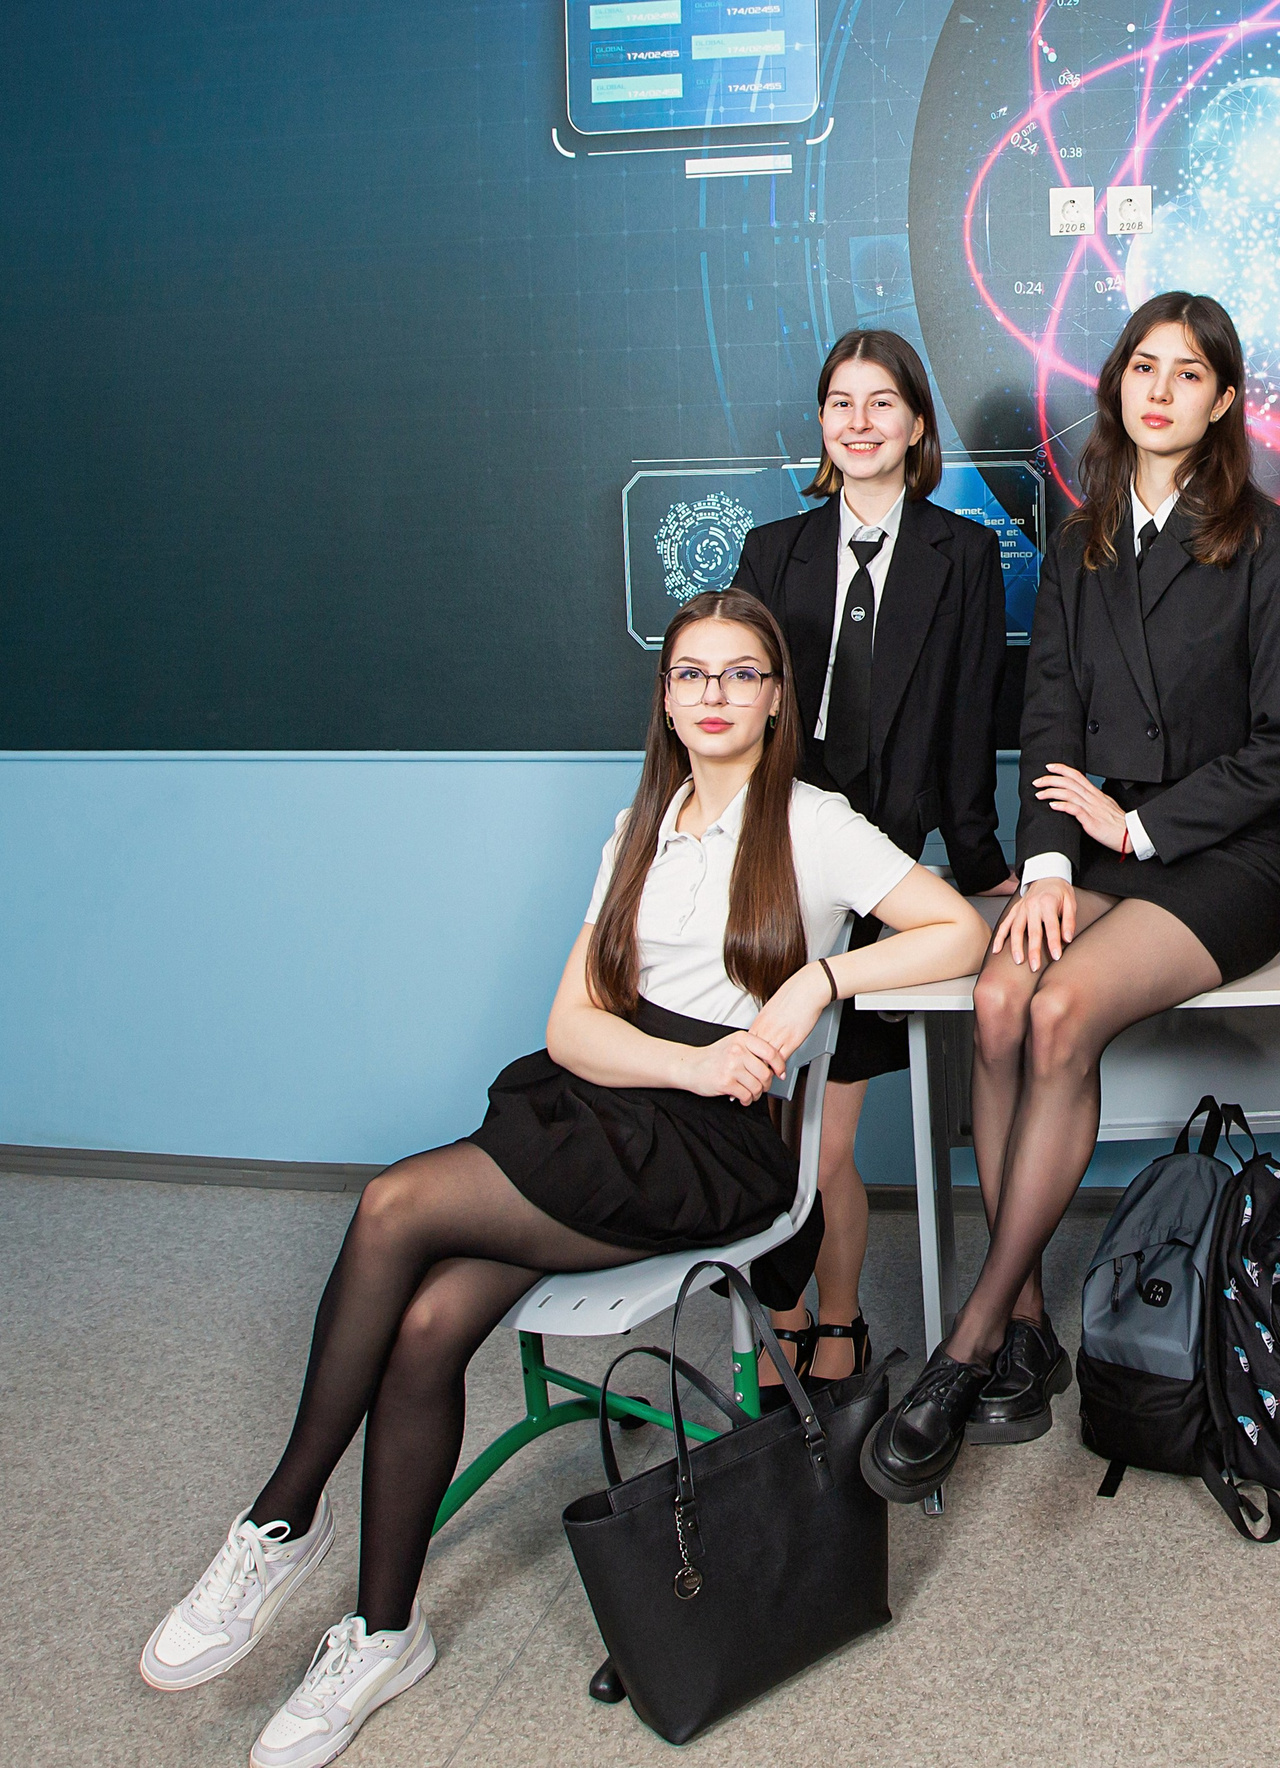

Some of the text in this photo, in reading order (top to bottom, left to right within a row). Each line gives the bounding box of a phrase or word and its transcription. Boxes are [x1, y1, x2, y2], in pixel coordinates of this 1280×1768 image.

[627, 50, 680, 60] 174/02455
[1021, 122, 1037, 137] 0.72
[1010, 132, 1038, 155] 0.24
[1060, 147, 1083, 159] 0.38
[1014, 281, 1042, 295] 0.24
[1094, 274, 1123, 294] 0.24
[954, 508, 985, 516] amet,
[984, 518, 1005, 526] sed
